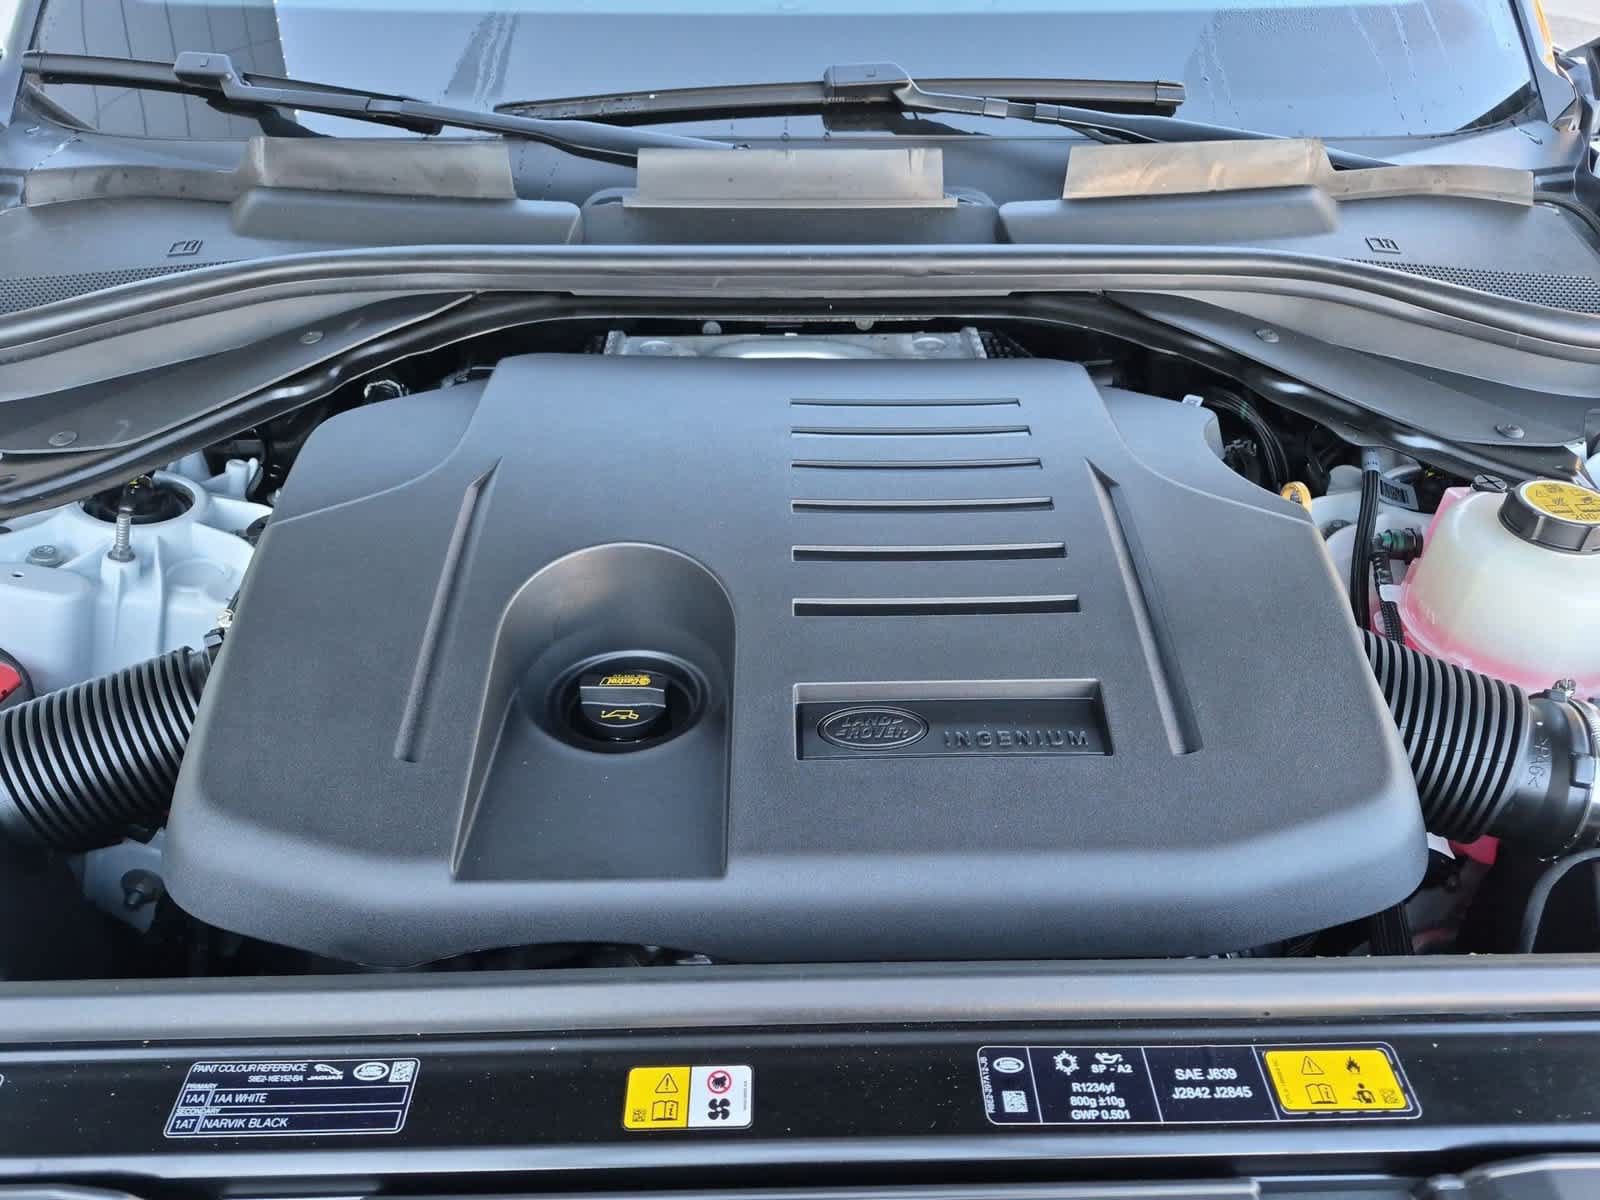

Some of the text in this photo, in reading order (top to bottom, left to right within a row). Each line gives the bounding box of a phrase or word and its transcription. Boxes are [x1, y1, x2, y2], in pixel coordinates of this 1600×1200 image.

[846, 727, 909, 739] ROVER
[944, 730, 1089, 746] INGENIUM
[193, 1063, 308, 1072] PAINT COLOUR REFERENCE
[1175, 1068, 1204, 1080] SAE
[214, 1092, 268, 1103] 1AA WHITE
[1172, 1086, 1253, 1098] J2842 J2845
[185, 1093, 206, 1103] 1AA
[1072, 1110, 1099, 1120] GWP
[175, 1119, 197, 1129] 1AT
[202, 1117, 288, 1129] NARVIK BLACK
